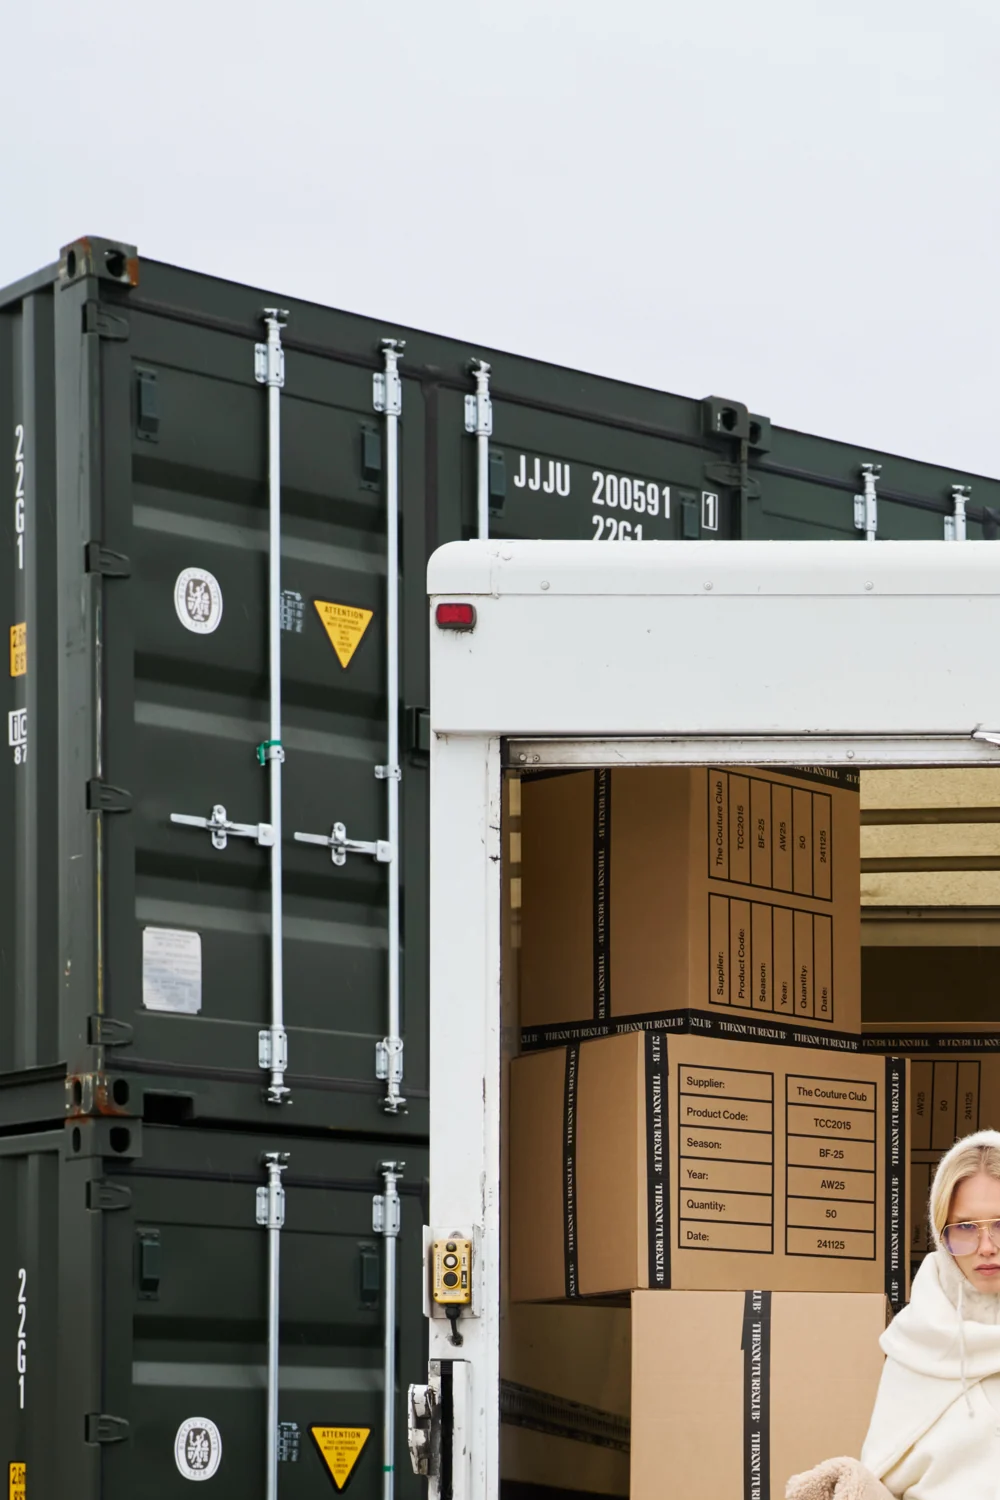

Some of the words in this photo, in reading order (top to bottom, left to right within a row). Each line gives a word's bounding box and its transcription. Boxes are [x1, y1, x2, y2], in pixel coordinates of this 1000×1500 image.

[514, 454, 570, 497] JJJU
[592, 470, 671, 519] 200591
[705, 495, 714, 528] 1
[324, 605, 364, 620] ATTENTION
[799, 835, 806, 849] 50
[717, 951, 725, 995] Supplier:
[800, 965, 808, 1009] Quantity:
[686, 1076, 725, 1089] Supplier:
[796, 1086, 813, 1097] The
[814, 1088, 848, 1100] Couture
[848, 1091, 867, 1102] Club
[916, 1091, 925, 1117] AW25
[940, 1100, 948, 1112] 50
[686, 1106, 722, 1120] Product
[722, 1110, 748, 1121] Code:
[814, 1118, 852, 1130] TCC2015
[686, 1137, 722, 1150] Season:
[819, 1148, 845, 1159] BF-25
[686, 1169, 709, 1180] Year:
[820, 1180, 846, 1190] AW25
[686, 1199, 726, 1212] Quantity:
[825, 1209, 837, 1218] 50
[686, 1231, 710, 1242] Date:
[817, 1239, 846, 1250] 241125
